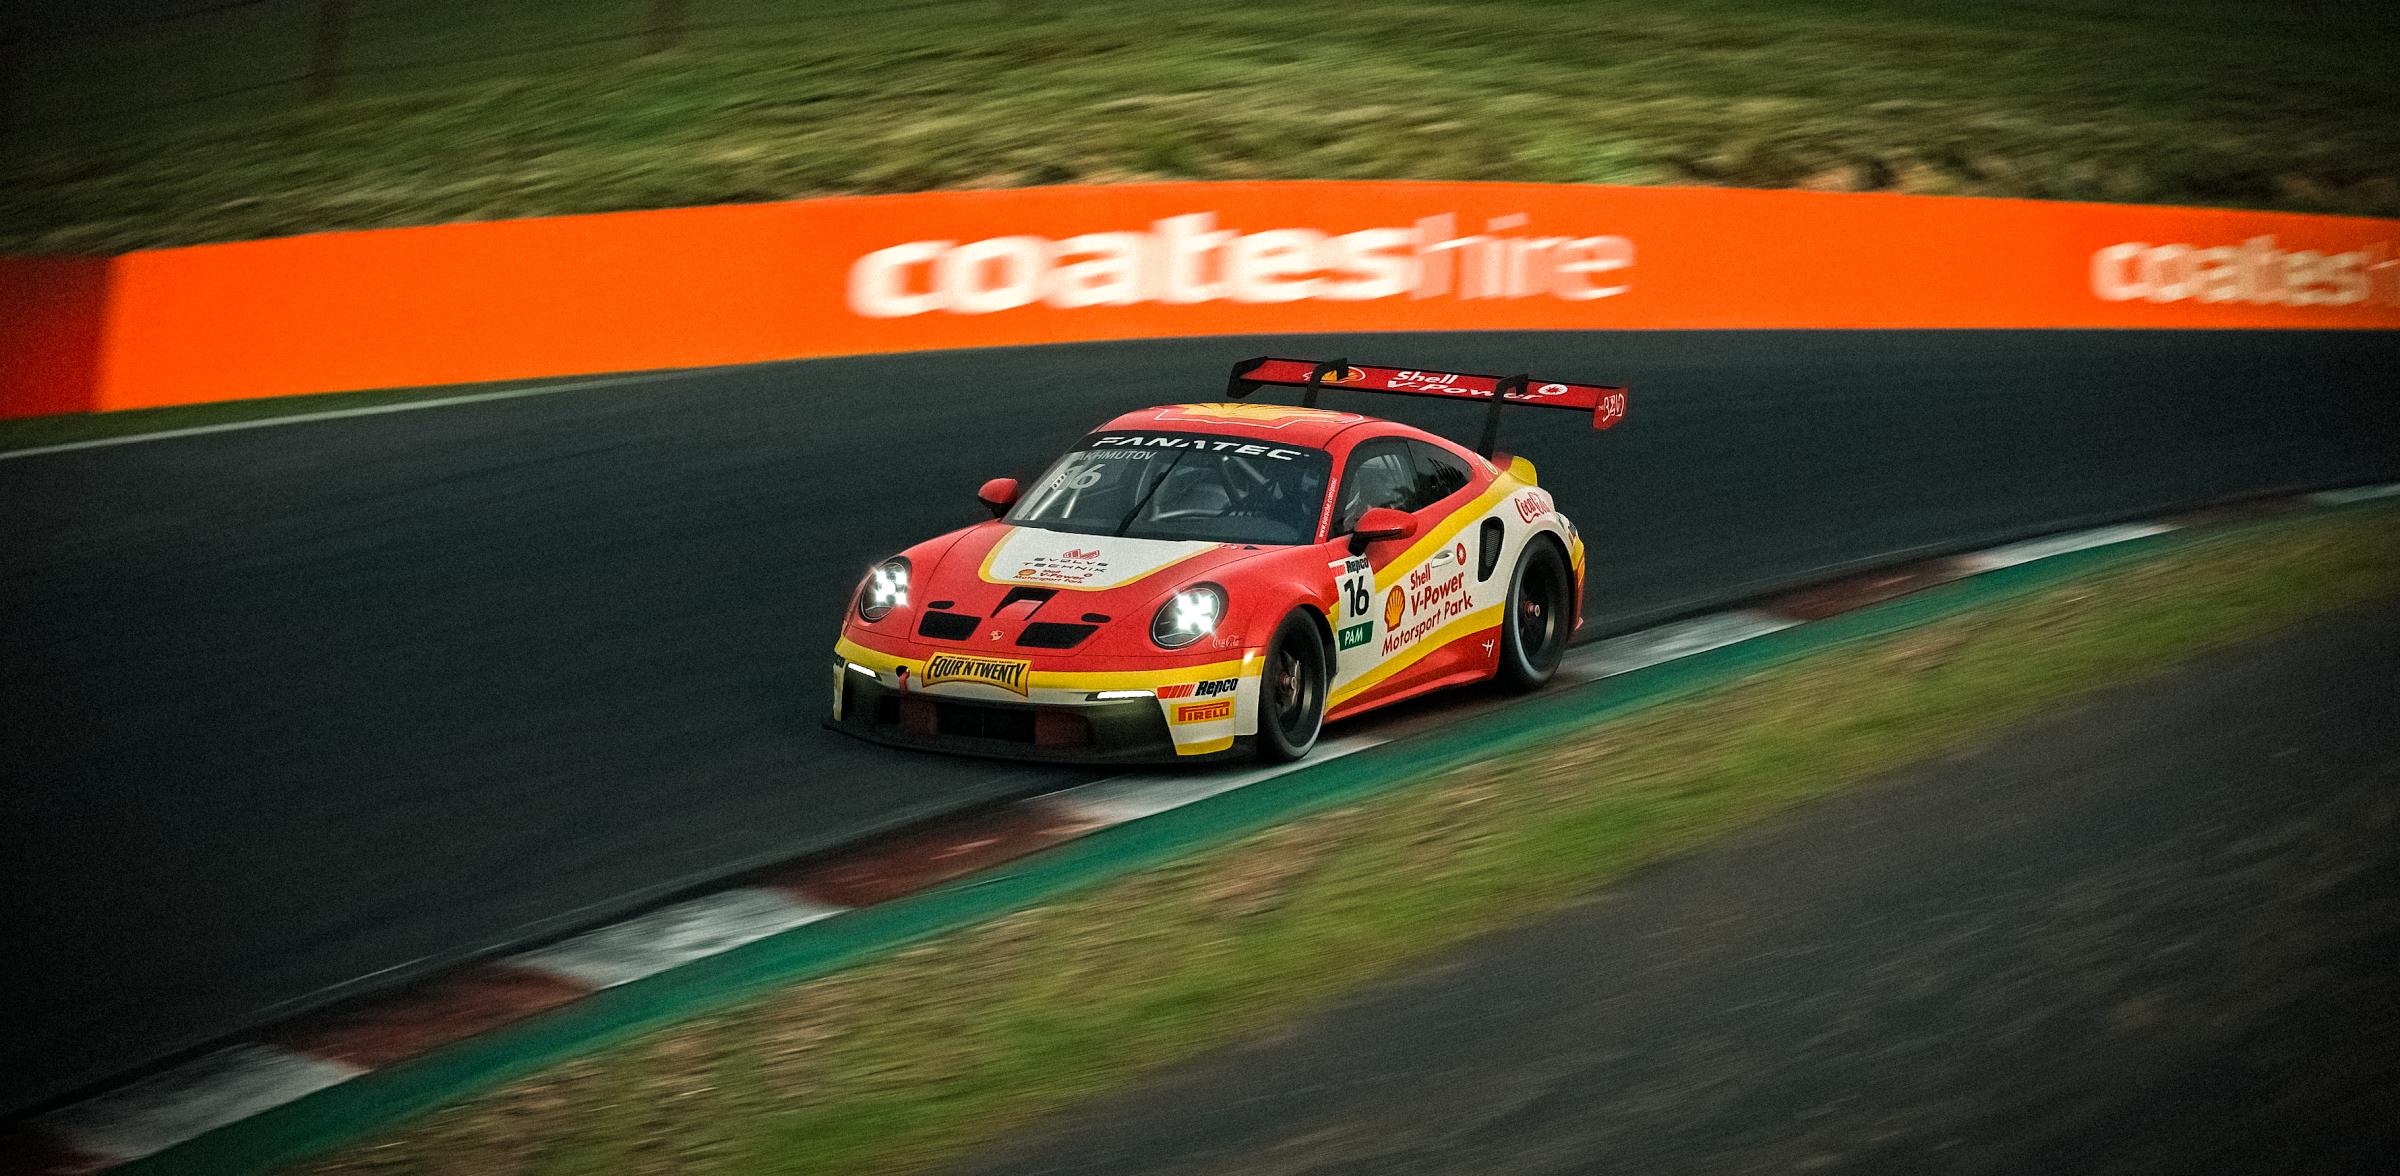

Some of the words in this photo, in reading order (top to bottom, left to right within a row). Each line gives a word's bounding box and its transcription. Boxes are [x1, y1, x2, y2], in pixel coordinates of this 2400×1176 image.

[1393, 370, 1459, 385] Shell
[1092, 436, 1302, 461] FANATEC
[1023, 561, 1108, 573] TECHNIK
[1345, 557, 1370, 574] Repco
[1410, 562, 1432, 591] Shell
[1343, 575, 1370, 618] 16
[1410, 571, 1465, 617] V-Power
[1381, 608, 1442, 657] Motorsport
[1443, 590, 1474, 621] Park
[1344, 626, 1364, 647] PAM
[1194, 678, 1239, 697] Repco
[1178, 701, 1231, 722] PIRELLI
